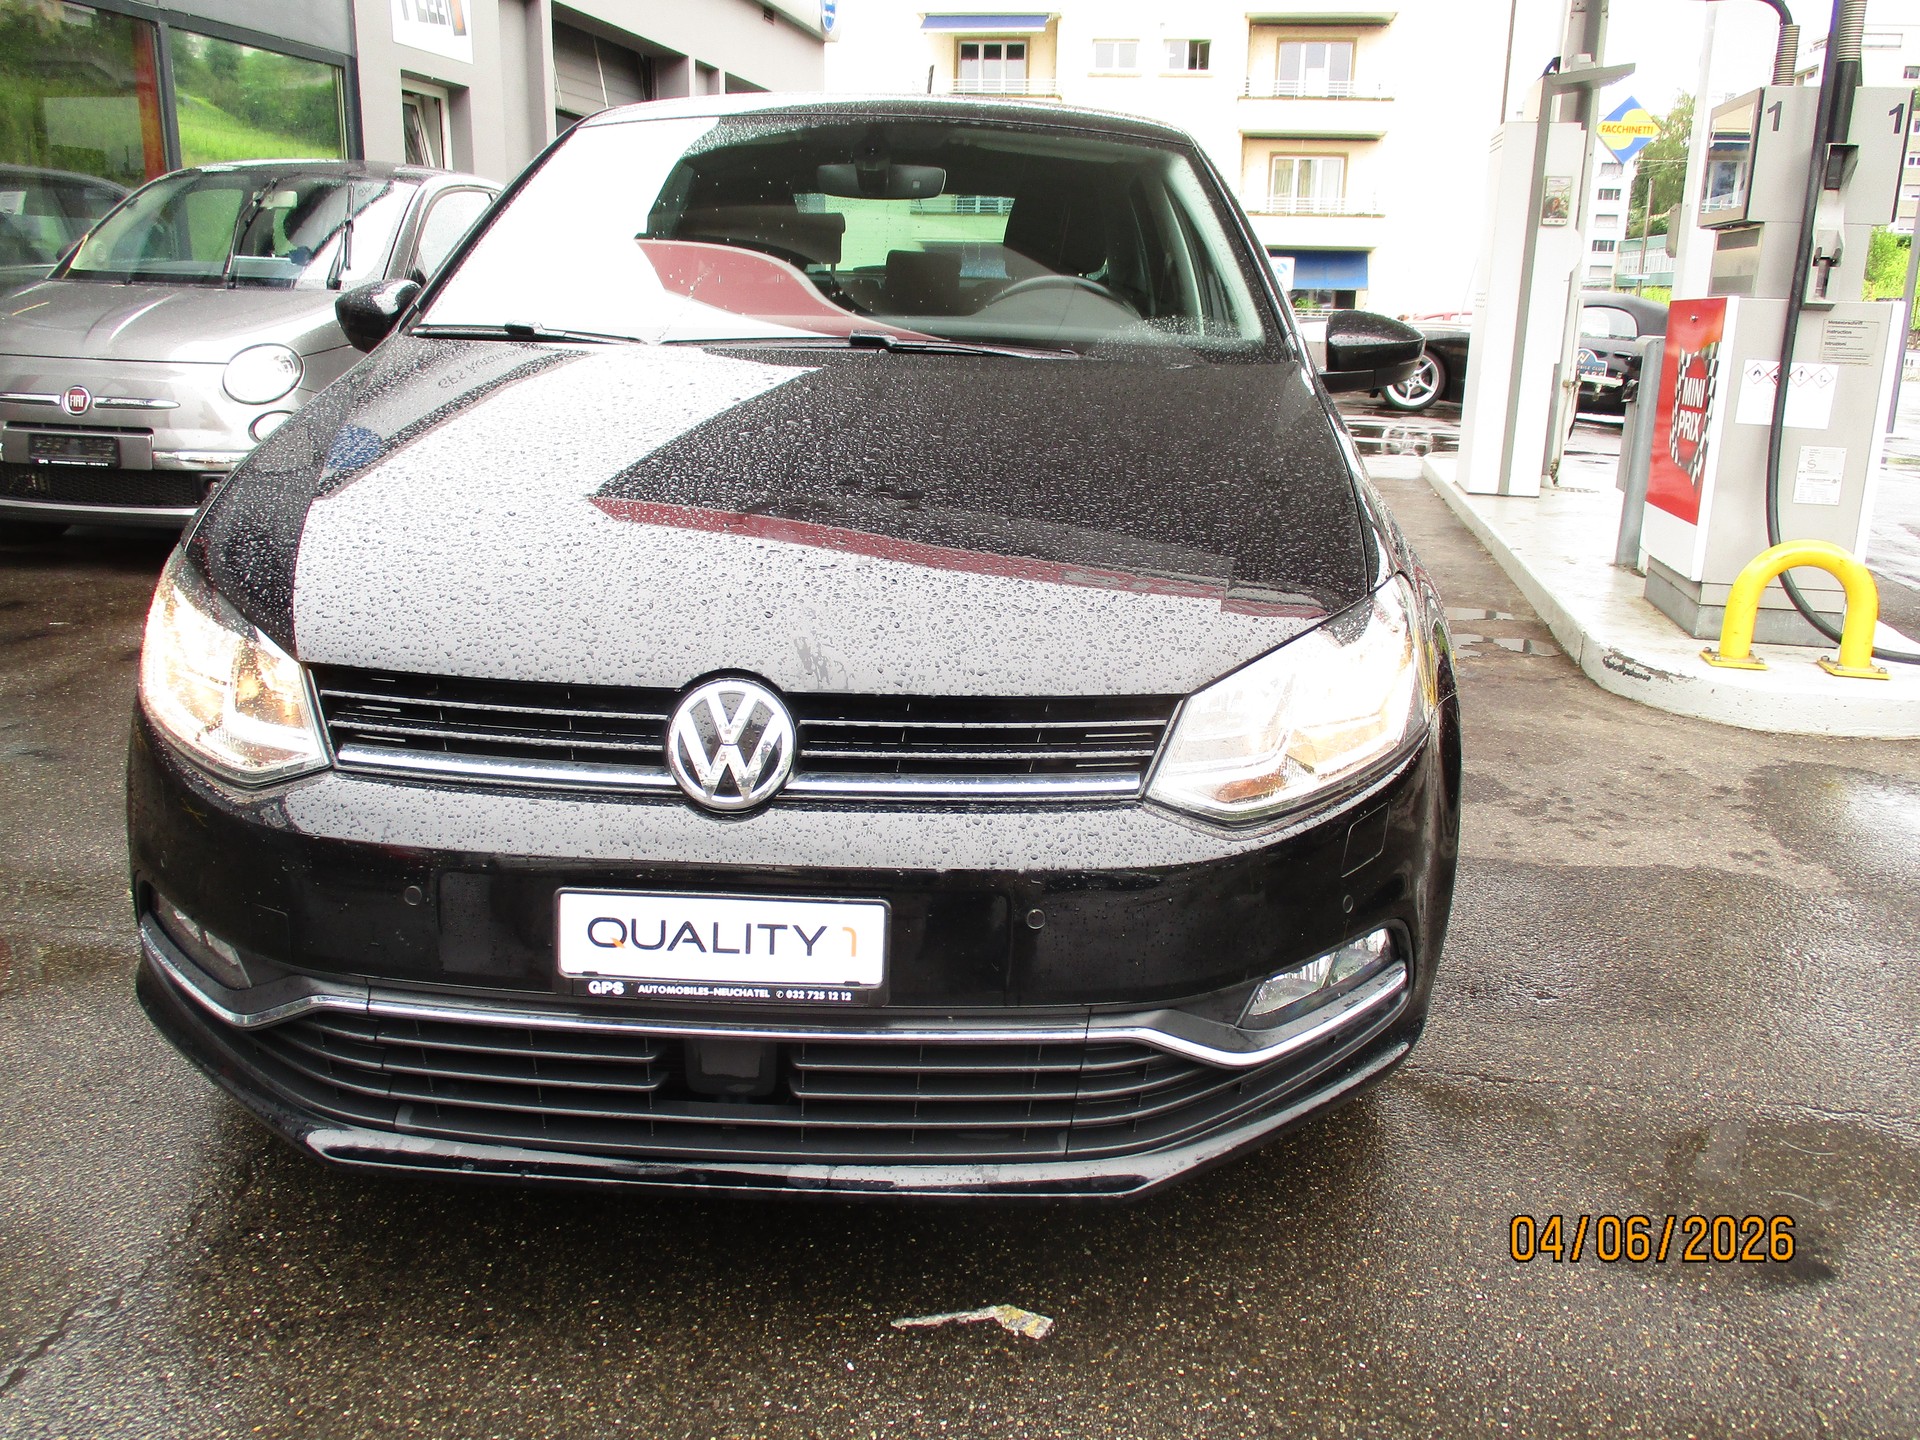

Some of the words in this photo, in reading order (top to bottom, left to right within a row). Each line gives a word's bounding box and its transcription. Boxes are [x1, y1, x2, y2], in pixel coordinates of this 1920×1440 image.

[1601, 124, 1654, 135] FACCHINETTI
[1767, 101, 1783, 131] 1
[1888, 103, 1905, 134] 1
[70, 395, 86, 407] FIAT
[1681, 376, 1706, 408] MINI
[1677, 409, 1702, 442] PRIX
[587, 916, 828, 957] QUALITY
[842, 926, 857, 957] 1
[588, 980, 625, 995] GPS
[637, 984, 770, 998] AUTOMOBILES-NEUCHATEL
[786, 989, 804, 999] 032
[807, 990, 825, 1000] 725
[828, 991, 839, 1001] 12
[841, 991, 852, 1001] 12
